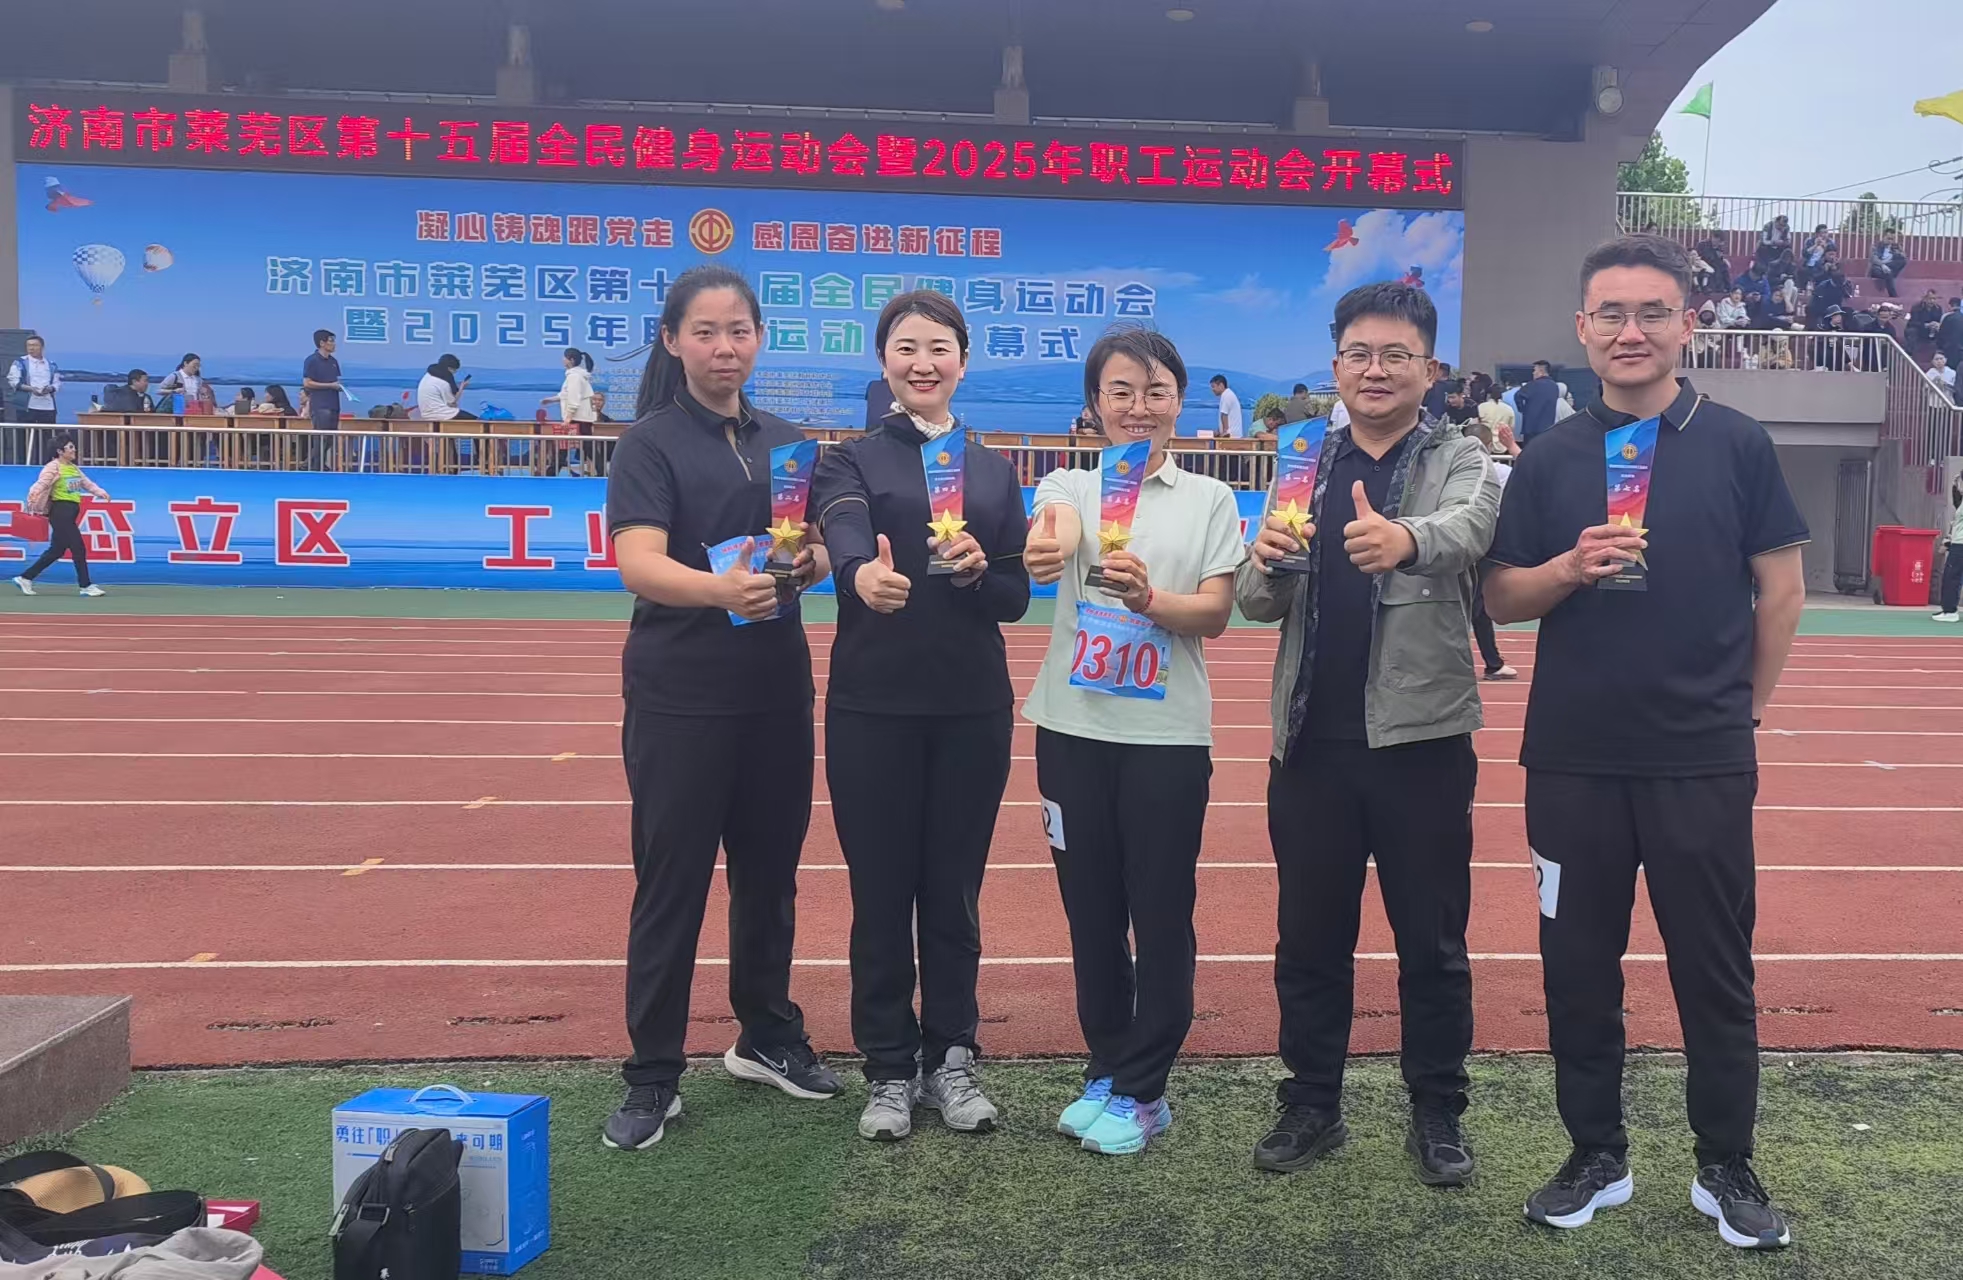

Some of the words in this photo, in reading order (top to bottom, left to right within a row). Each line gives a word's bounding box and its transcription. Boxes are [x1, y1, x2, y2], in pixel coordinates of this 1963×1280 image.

[27, 102, 1454, 195] 济南市莱芜区第十五届全民健身运动会暨2025年职工运动会开幕式
[416, 210, 674, 247] 凝心铸魂跟党走
[751, 220, 1002, 258] 感恩奋进新征程
[265, 256, 1156, 317] 济南市莱芜区第十届全民身运动会
